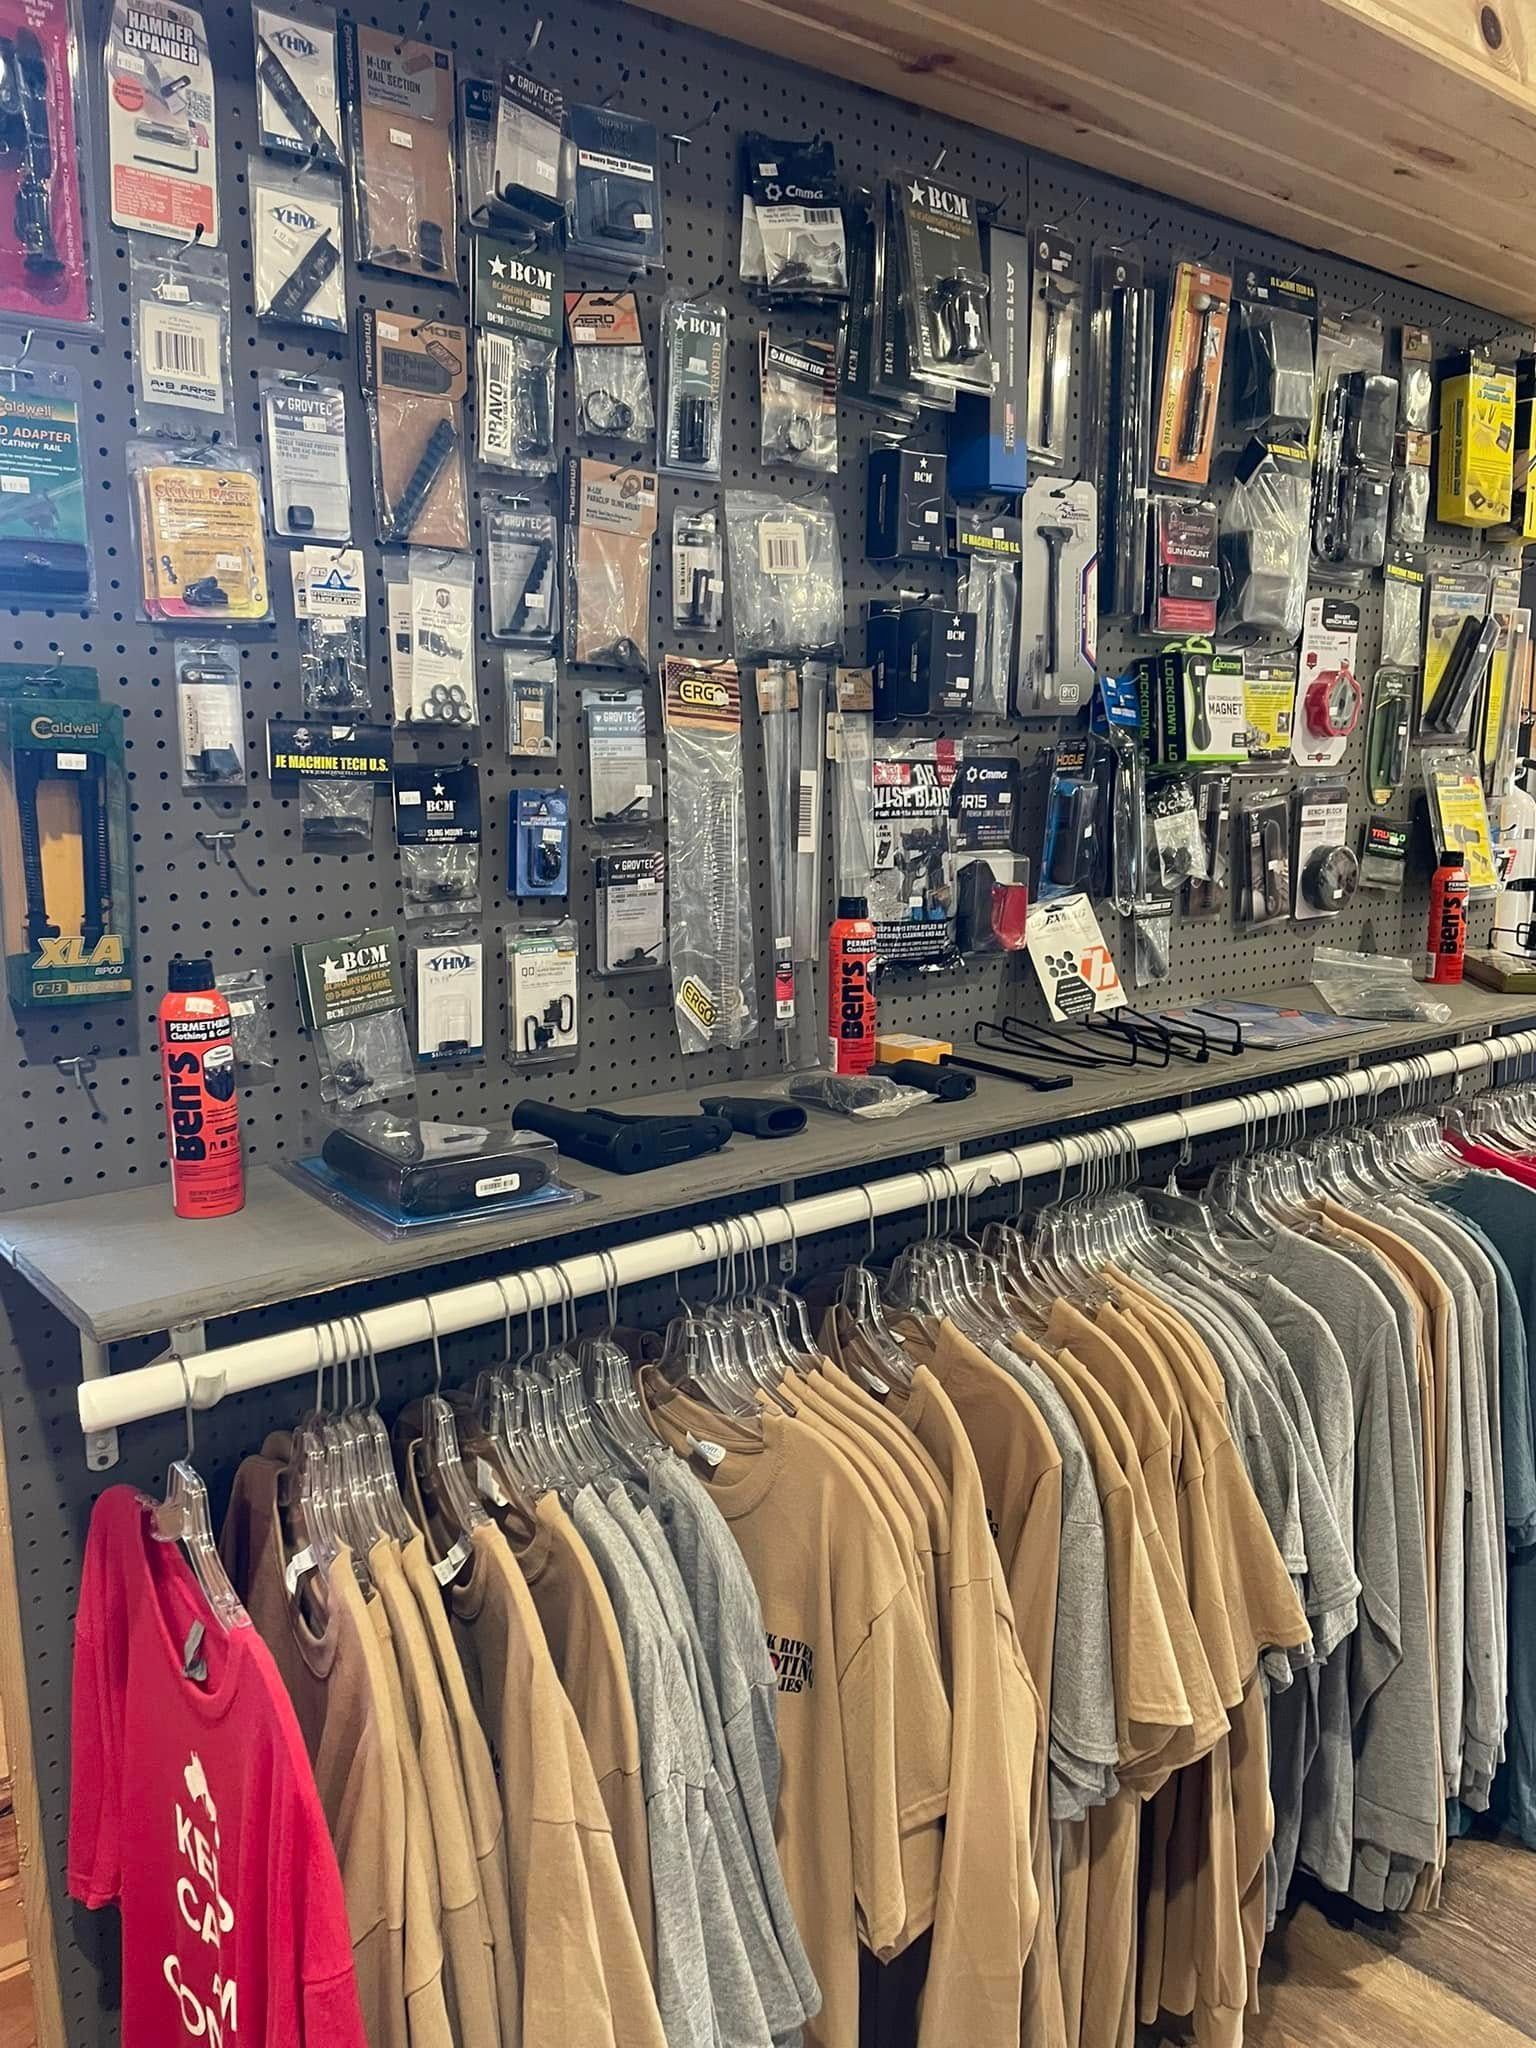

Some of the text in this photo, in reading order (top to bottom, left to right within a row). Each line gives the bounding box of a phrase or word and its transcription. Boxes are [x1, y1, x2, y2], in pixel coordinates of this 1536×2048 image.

[128, 9, 195, 44] HAMMER
[124, 27, 200, 66] EXPANDER
[275, 33, 314, 56] YHM
[367, 56, 392, 73] M-LOK
[367, 70, 421, 95] RAIL SECTION
[517, 76, 555, 105] GROVTEC
[276, 137, 303, 152] SINCE
[589, 154, 606, 164] Heavy
[607, 158, 619, 168] Duty
[929, 186, 970, 218] BCM
[277, 208, 316, 230] YHM
[511, 261, 552, 290] BCM
[1006, 262, 1015, 322] AR15
[302, 315, 323, 326] 1951
[487, 312, 504, 325] BCM
[575, 314, 615, 325] AERO
[690, 317, 722, 337] BCM
[420, 327, 462, 341] MOE
[922, 318, 932, 358] BCM
[364, 325, 373, 383] MAGPUL
[885, 342, 894, 375] BCM
[785, 355, 809, 372] MACHINE
[810, 363, 825, 376] TECH
[848, 350, 859, 382] BCM
[709, 342, 722, 412] EXTENDED
[181, 384, 217, 397] ARMS
[0, 396, 52, 418] Caldwell
[288, 398, 333, 416] GROVTEC
[488, 383, 502, 448] BRAVO
[1164, 401, 1176, 446] BRASS
[13, 427, 72, 444] ADAPTER
[44, 443, 63, 453] RAIL
[914, 472, 932, 484] BCM
[568, 472, 578, 521] MAGPUL
[626, 500, 640, 512] MOUNT
[504, 515, 542, 530] GROVTEC
[968, 535, 993, 549] MACHINE
[994, 540, 1010, 552] TECH
[1010, 542, 1021, 553] U.S.
[1167, 547, 1210, 558] GUN MOUNT
[947, 630, 966, 641] BCM
[1140, 664, 1150, 739] LOCKDOWN
[1165, 660, 1177, 735] LOCKDOWN
[603, 712, 638, 722] GROVTEC
[1208, 703, 1243, 716] MAGNET
[31, 716, 99, 740] Caldwell
[276, 755, 389, 772] JE MACHINE TECH U.S.
[1056, 754, 1085, 768] HOGUE
[914, 764, 939, 785] AR
[426, 800, 454, 812] BCM
[874, 787, 912, 808] VISE
[1308, 808, 1342, 816] BENCH BLOCK
[427, 828, 464, 837] SLING MOUNT
[622, 860, 654, 871] GROVTEC
[1440, 897, 1461, 955] Ben's
[32, 935, 124, 969] XLA
[341, 943, 388, 970] BCM
[95, 966, 122, 976] BIPOD
[429, 956, 472, 971] YHM
[683, 988, 716, 1026] ERGO
[842, 960, 864, 1039] Ben's
[326, 1008, 345, 1020] BCM
[171, 1032, 208, 1041] Clothing
[169, 1051, 207, 1161] Ben's
